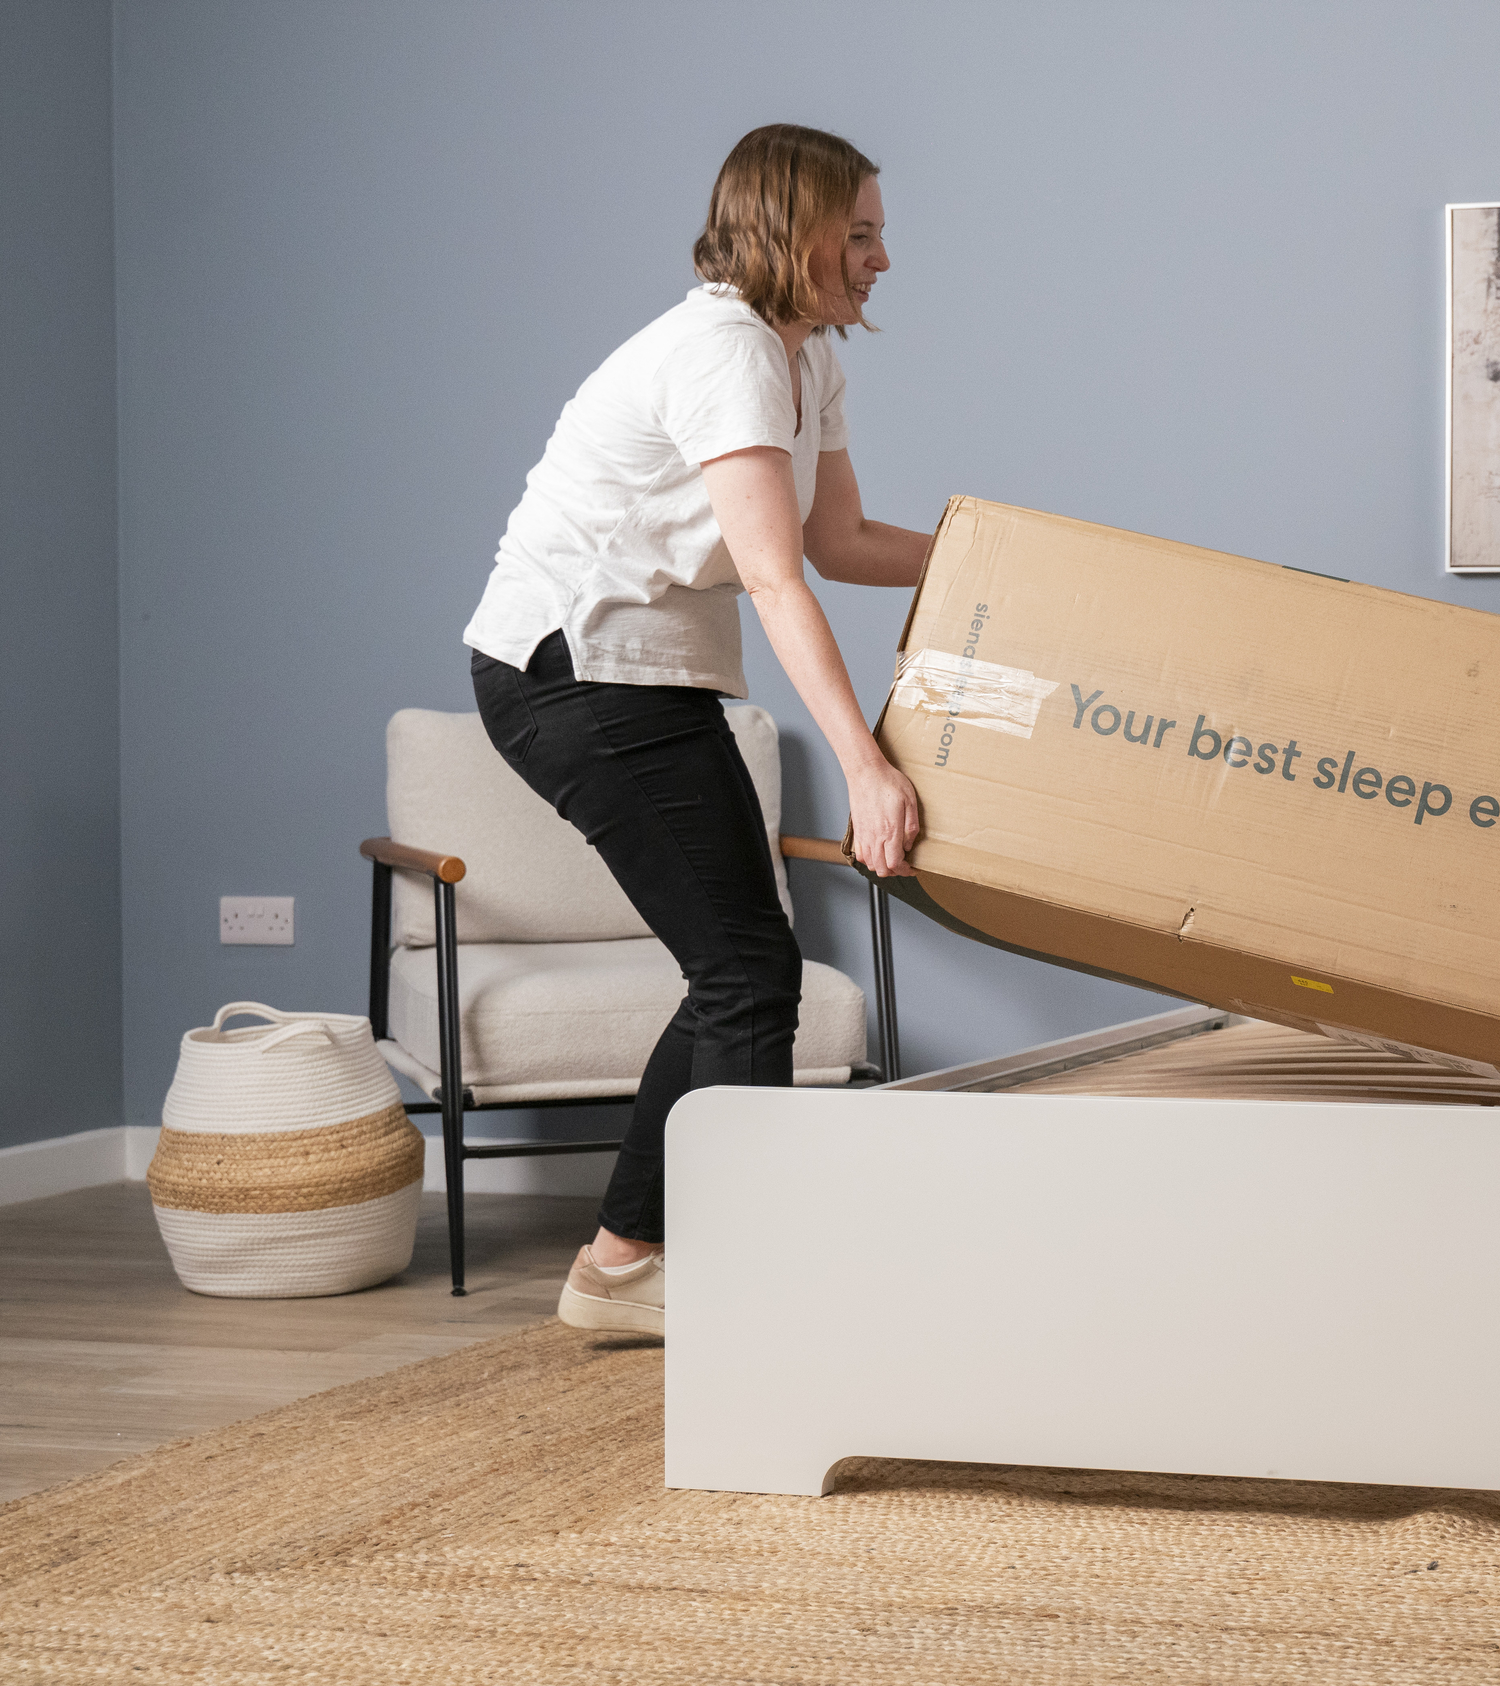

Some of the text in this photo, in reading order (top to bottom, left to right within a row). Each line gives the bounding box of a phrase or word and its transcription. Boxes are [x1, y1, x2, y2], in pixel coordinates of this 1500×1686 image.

[1069, 682, 1178, 750] Your
[1187, 714, 1303, 782] best
[1312, 749, 1453, 826] sleep
